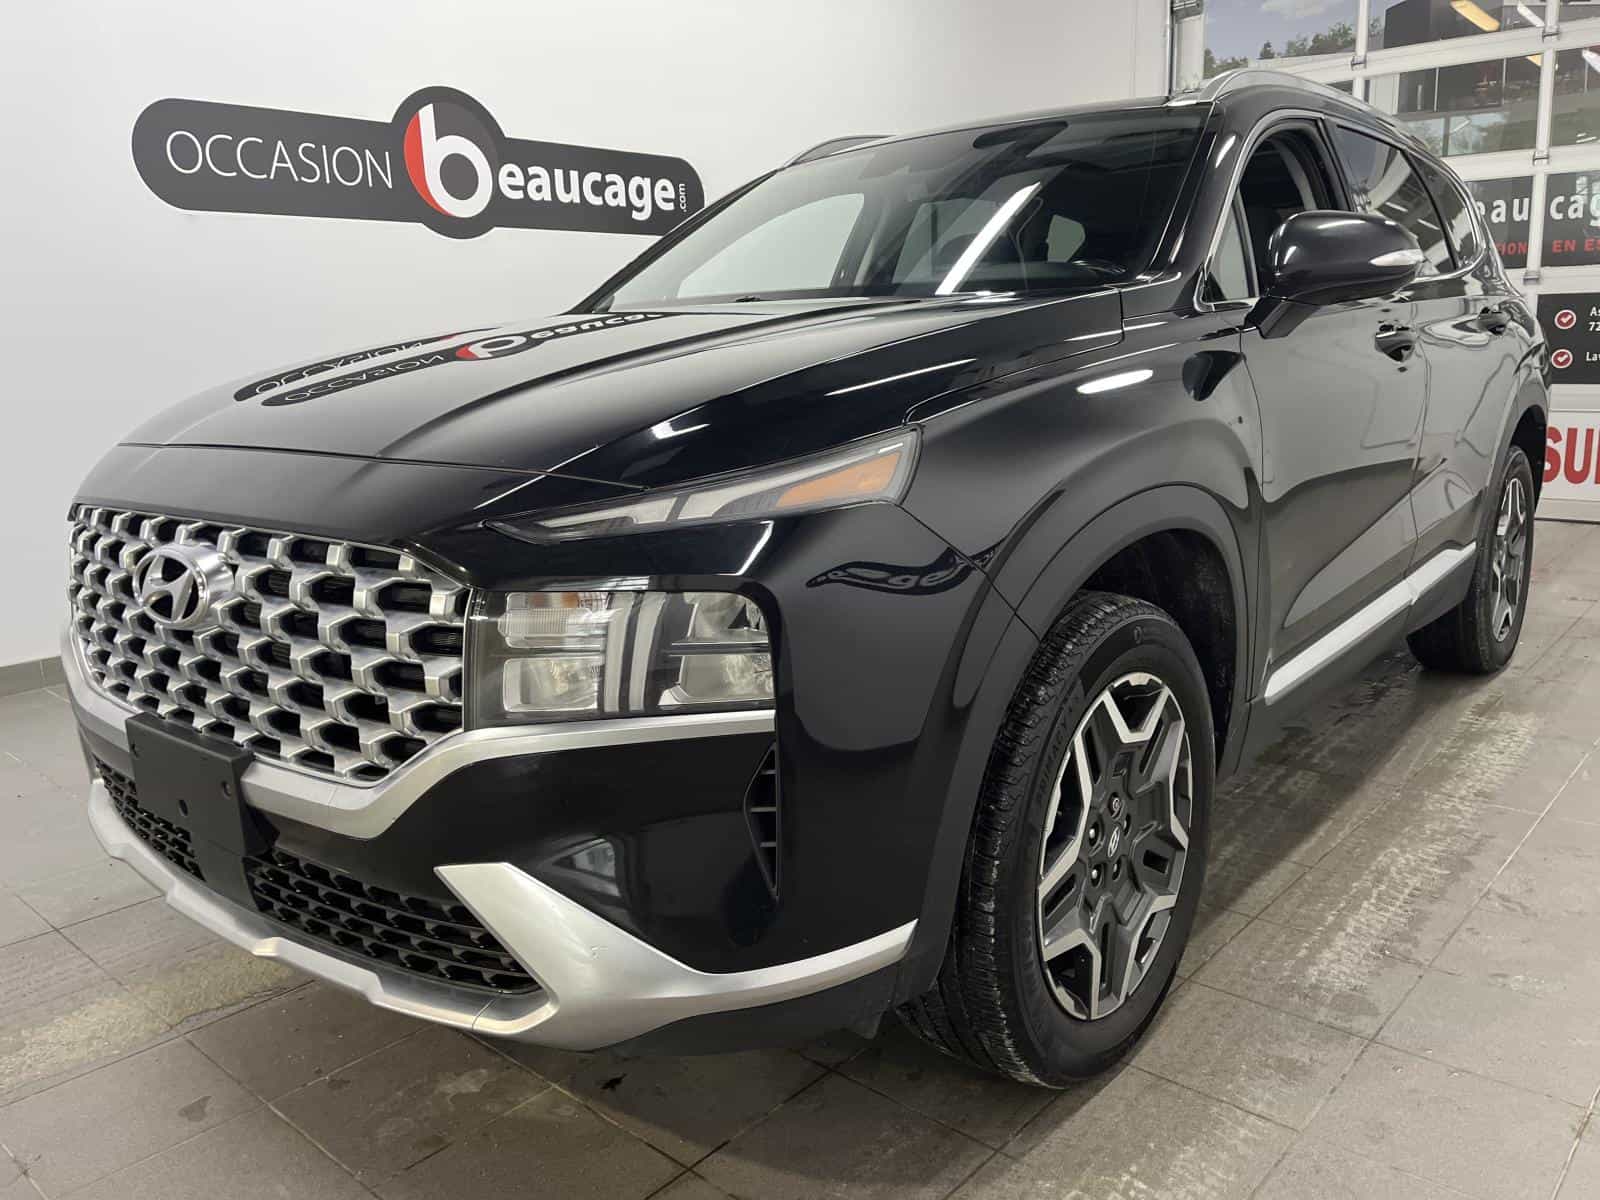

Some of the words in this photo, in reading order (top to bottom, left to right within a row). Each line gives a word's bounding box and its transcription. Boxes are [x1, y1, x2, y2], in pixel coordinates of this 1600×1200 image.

[166, 130, 393, 189] OCCASION
[1551, 239, 1576, 254] EN
[1543, 426, 1600, 485] SU
